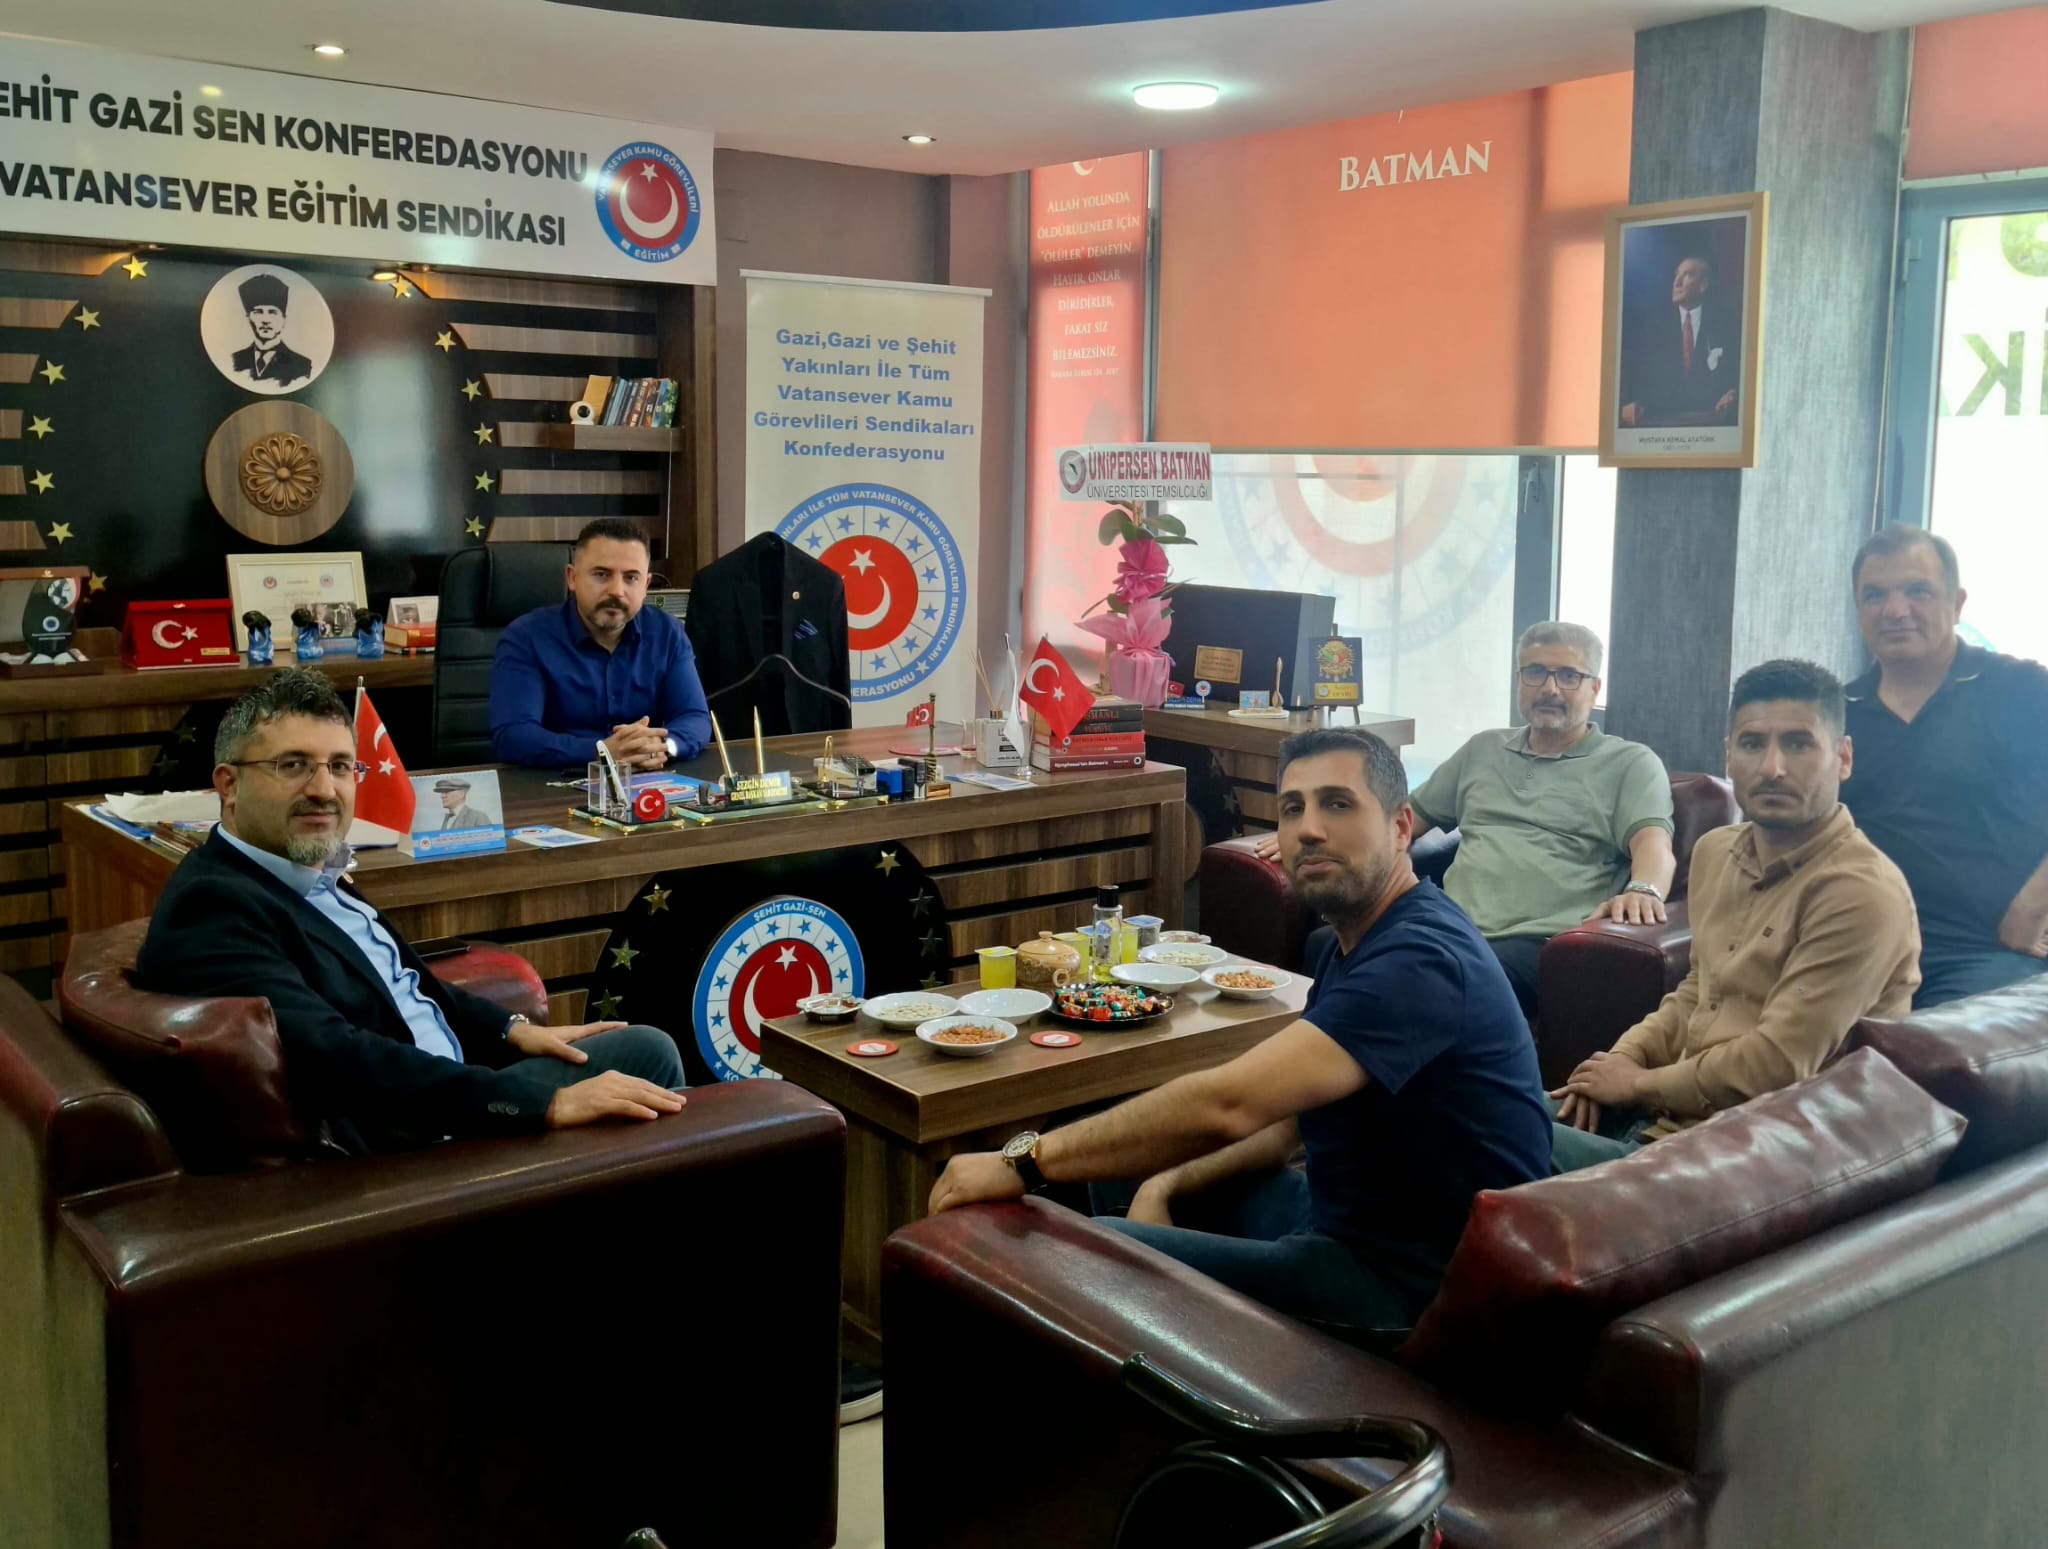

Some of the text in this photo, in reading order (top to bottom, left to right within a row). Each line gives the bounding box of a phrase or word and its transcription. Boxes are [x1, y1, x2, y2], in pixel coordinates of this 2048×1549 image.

[90, 90, 183, 136] GAZİ
[193, 105, 266, 146] SEN
[274, 116, 588, 183] KONFEREDASYONU
[634, 146, 662, 157] KAMU
[1337, 141, 1493, 192] BATMAN
[0, 161, 566, 247] VATANSEVER EĞİTİM SENDİKASI
[634, 249, 669, 260] EĞİTİM
[776, 329, 956, 356] Gazi,Gazi ve Şehit
[781, 357, 950, 382] Yakınları İle Tüm
[777, 385, 953, 408] Vatansever Kamu
[754, 412, 974, 436] Görevlileri Sendikaları
[784, 440, 945, 463] Konfederasyonu
[1160, 451, 1210, 480] BATMAN
[852, 490, 916, 514] VATANSEVER
[916, 509, 941, 535] KAMU
[851, 671, 915, 697] ERASYONU
[753, 903, 782, 922] ŞEHİT
